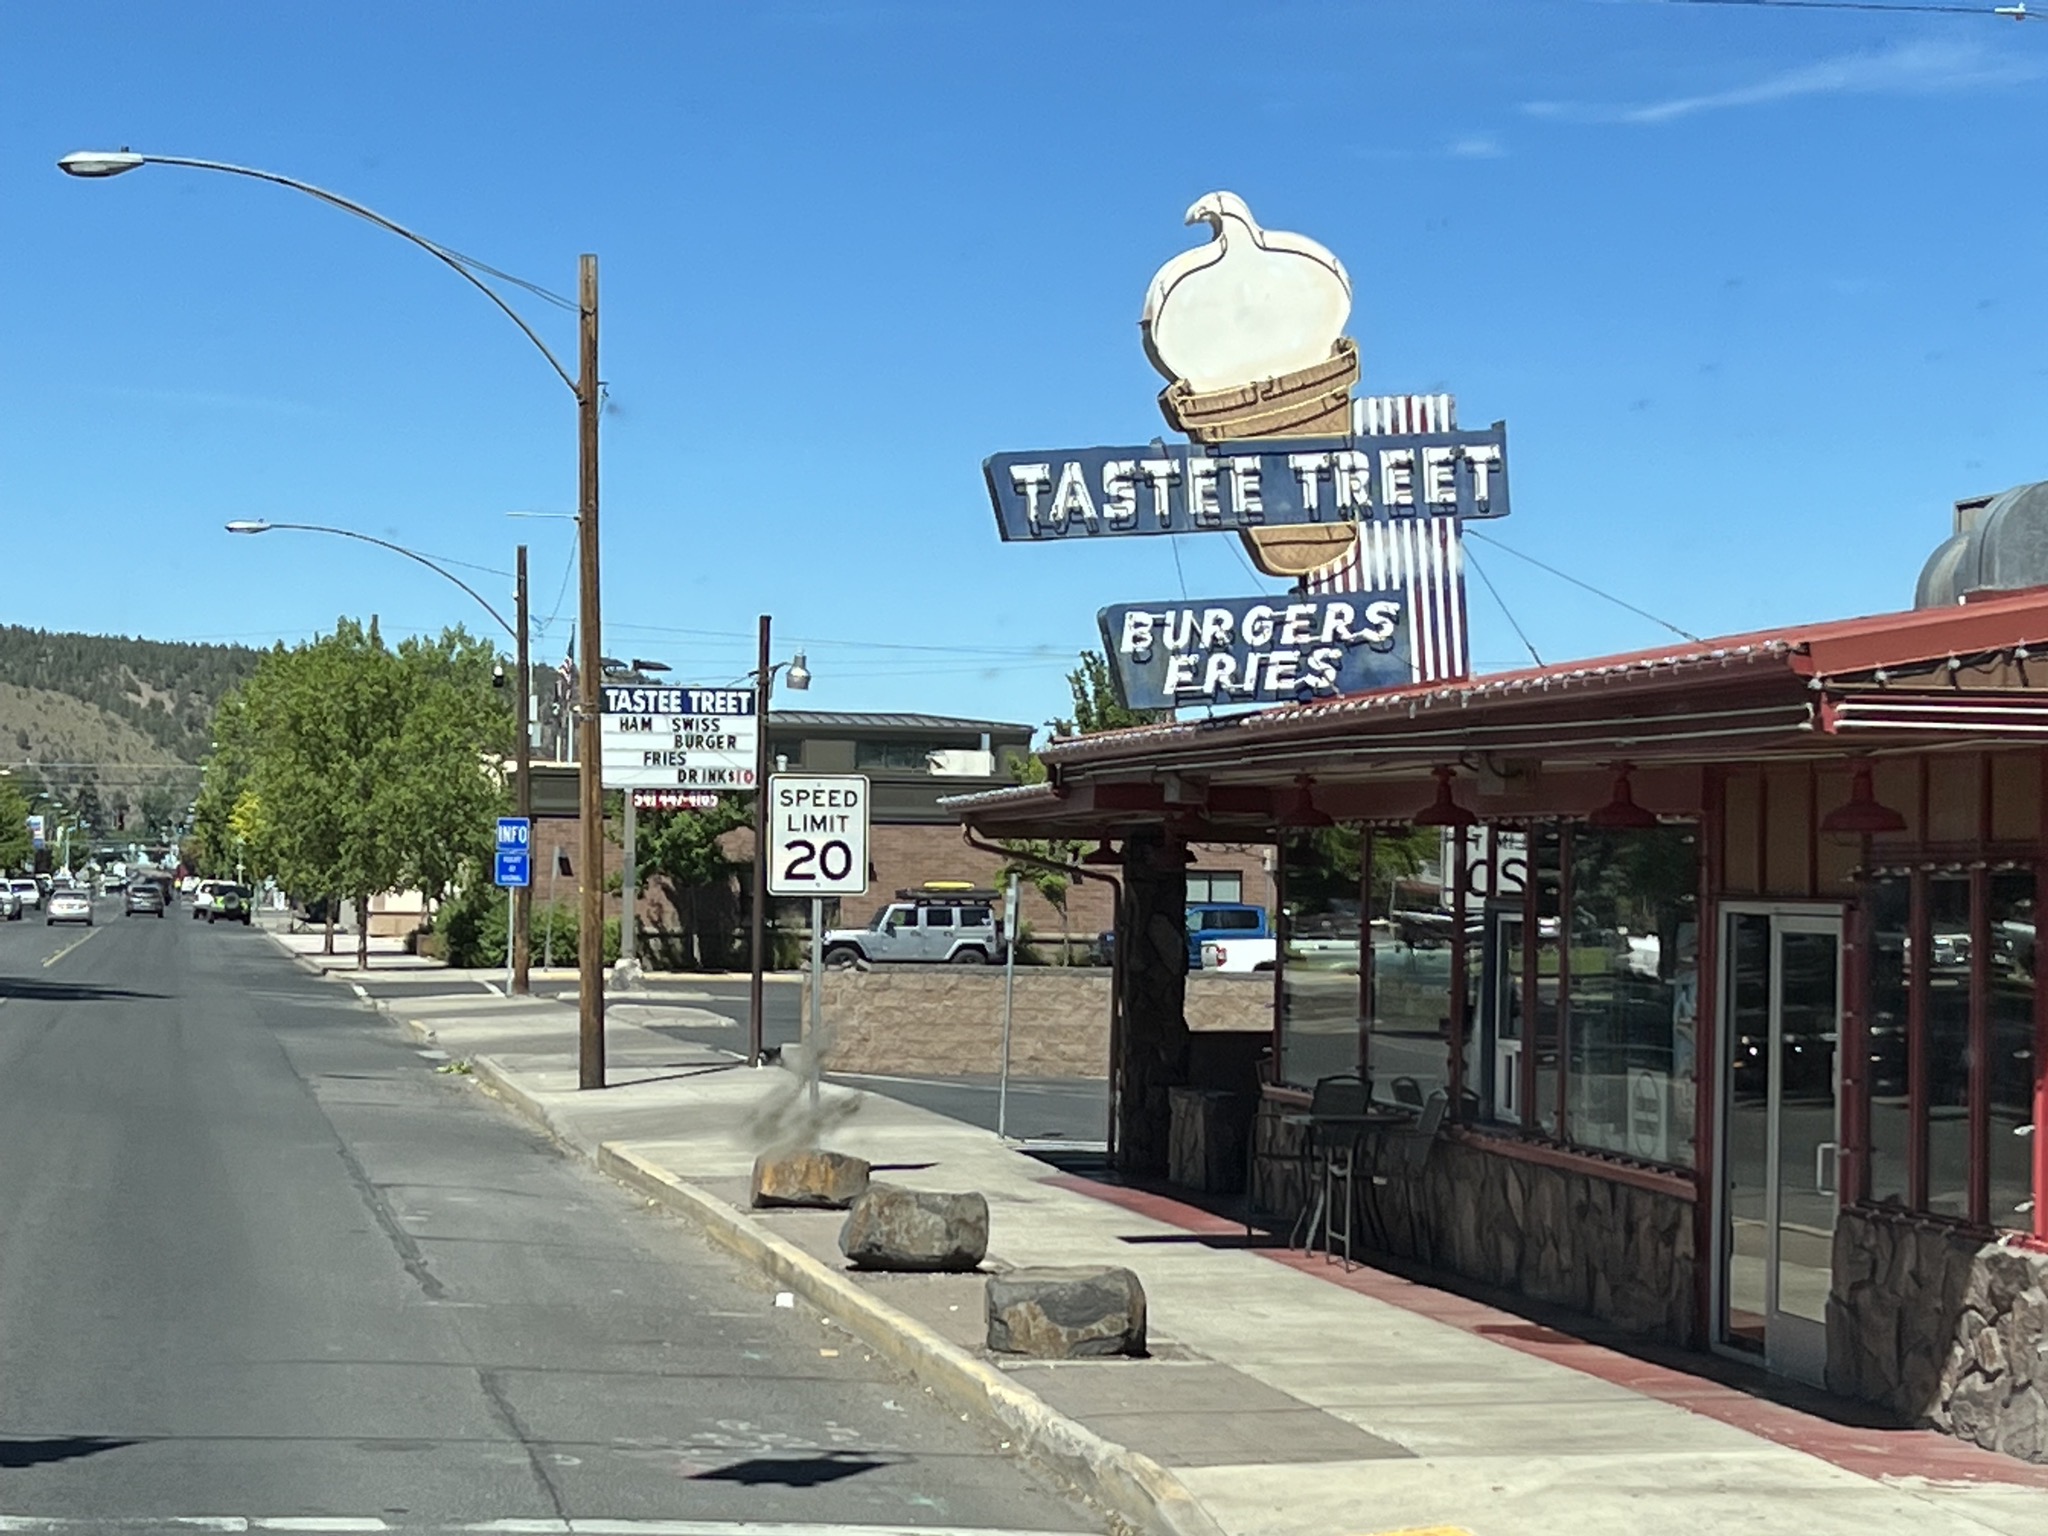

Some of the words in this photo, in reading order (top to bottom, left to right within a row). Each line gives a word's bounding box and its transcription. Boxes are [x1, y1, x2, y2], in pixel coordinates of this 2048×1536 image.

[1009, 455, 1263, 523] TASTEE
[1288, 444, 1501, 513] TREET
[1120, 600, 1401, 654] BURGERS
[1163, 646, 1344, 695] FRIES
[605, 689, 682, 713] TASTEE
[688, 692, 751, 714] TREET
[619, 716, 652, 732] HAM
[672, 717, 720, 732] SWISS
[674, 734, 737, 750] BURGER
[643, 751, 687, 766] FRIES
[780, 789, 859, 808] SPEED
[787, 815, 850, 833] LIMIT
[498, 825, 528, 843] INFO
[784, 840, 852, 881] 20
